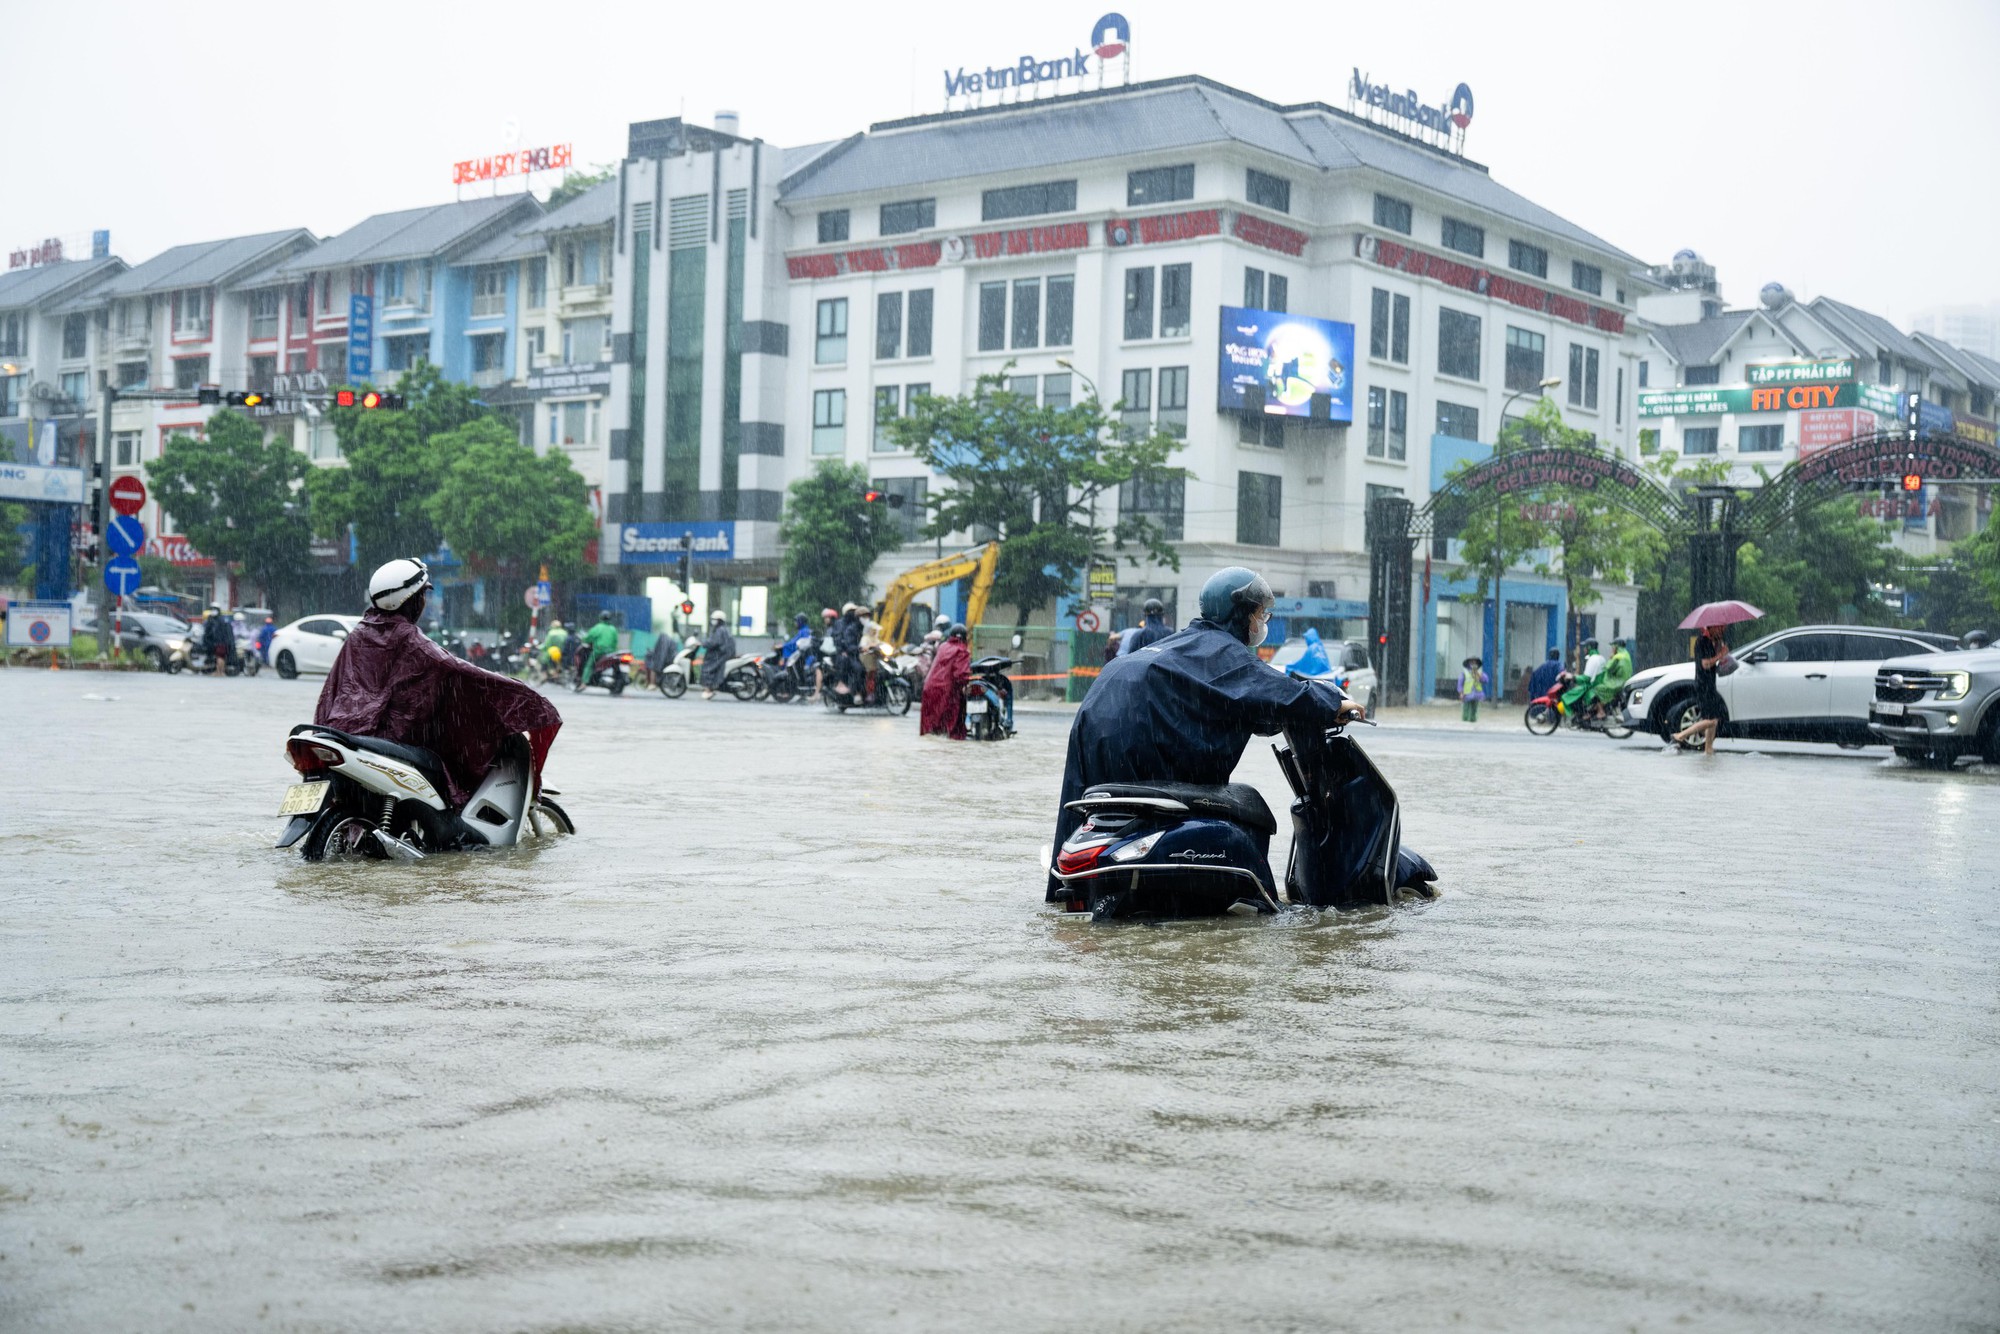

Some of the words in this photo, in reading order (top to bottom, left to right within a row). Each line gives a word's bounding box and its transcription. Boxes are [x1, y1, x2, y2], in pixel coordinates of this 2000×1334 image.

[944, 47, 1092, 96] VietinBank
[1353, 67, 1451, 136] VietinBank
[1777, 369, 1791, 380] PT
[1751, 388, 1784, 411] FIT
[1787, 385, 1840, 409] CITY
[1496, 465, 1594, 492] GELEXIMCO
[1838, 458, 1957, 484] GELEXIMCO
